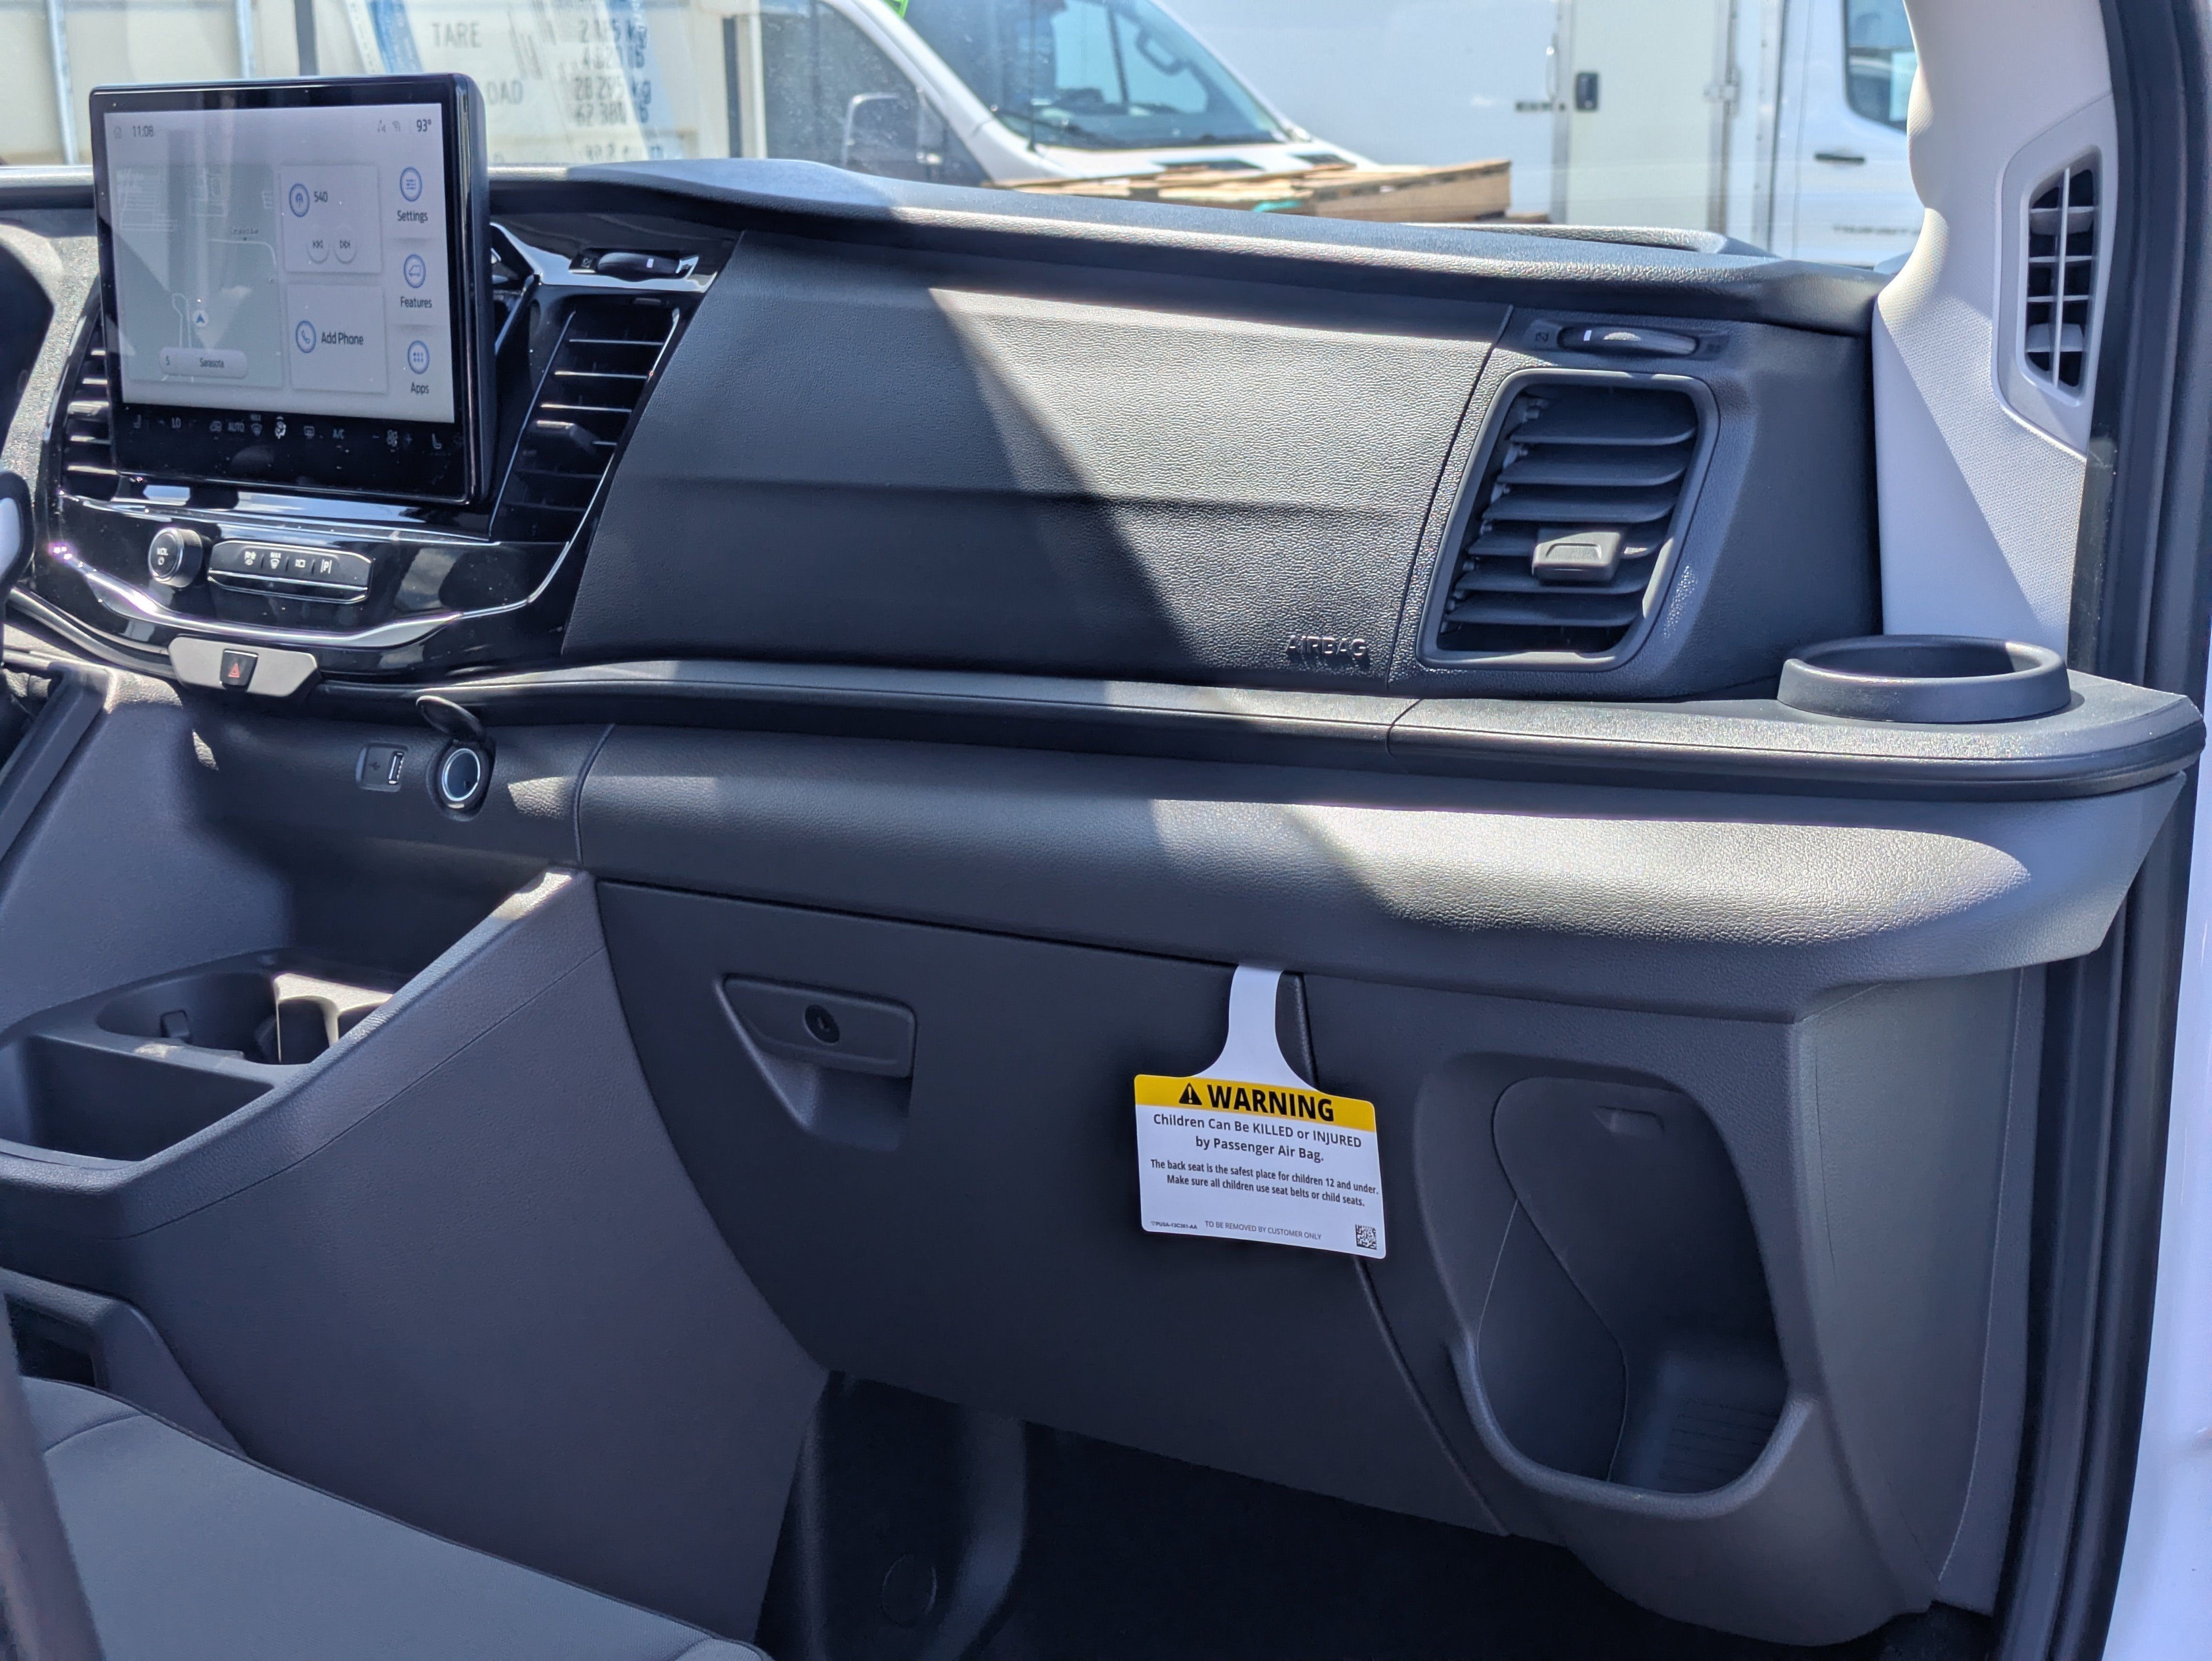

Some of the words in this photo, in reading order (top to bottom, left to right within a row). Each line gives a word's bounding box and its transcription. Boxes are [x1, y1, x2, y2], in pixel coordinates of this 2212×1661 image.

[432, 22, 481, 48] TARE
[397, 210, 428, 223] Settings
[400, 296, 432, 308] Features
[321, 332, 337, 344] Add
[338, 332, 364, 345] Phone
[410, 382, 429, 395] Apps
[228, 422, 244, 432] AUTO
[1285, 635, 1368, 657] AIRBAG
[1206, 1084, 1334, 1122] WARNING
[1153, 1113, 1205, 1128] Children
[1208, 1118, 1231, 1130] Can
[1234, 1121, 1249, 1132] Be
[1253, 1123, 1294, 1138] KILLED
[1297, 1130, 1310, 1140] or
[1313, 1130, 1361, 1148] INJURED
[1196, 1135, 1210, 1151] by
[1214, 1138, 1274, 1156] Passenger
[1278, 1144, 1295, 1157] Air
[1299, 1147, 1324, 1163] Bag.
[1150, 1159, 1165, 1169] The
[1167, 1160, 1186, 1170] back
[1188, 1163, 1205, 1172] seat
[1206, 1163, 1213, 1173] is
[1215, 1164, 1228, 1174] the
[1230, 1166, 1253, 1177] safest
[1256, 1169, 1276, 1180] place
[1278, 1171, 1290, 1181] for
[1292, 1173, 1323, 1186] children
[1326, 1178, 1335, 1187] 12
[1337, 1180, 1351, 1190] and
[1353, 1183, 1379, 1195] under.
[1167, 1174, 1189, 1185] Make
[1191, 1178, 1208, 1186] sure
[1210, 1178, 1220, 1188] all
[1222, 1179, 1254, 1191] children
[1256, 1185, 1270, 1193] use
[1272, 1186, 1288, 1196] seat
[1290, 1186, 1309, 1198] belts
[1311, 1191, 1319, 1200] or
[1322, 1191, 1340, 1202] child
[1342, 1196, 1365, 1207] seats.
[1225, 1223, 1257, 1232] REMOVED
[1268, 1227, 1303, 1237] CUSTOMER
[1304, 1231, 1322, 1240] ONLY
